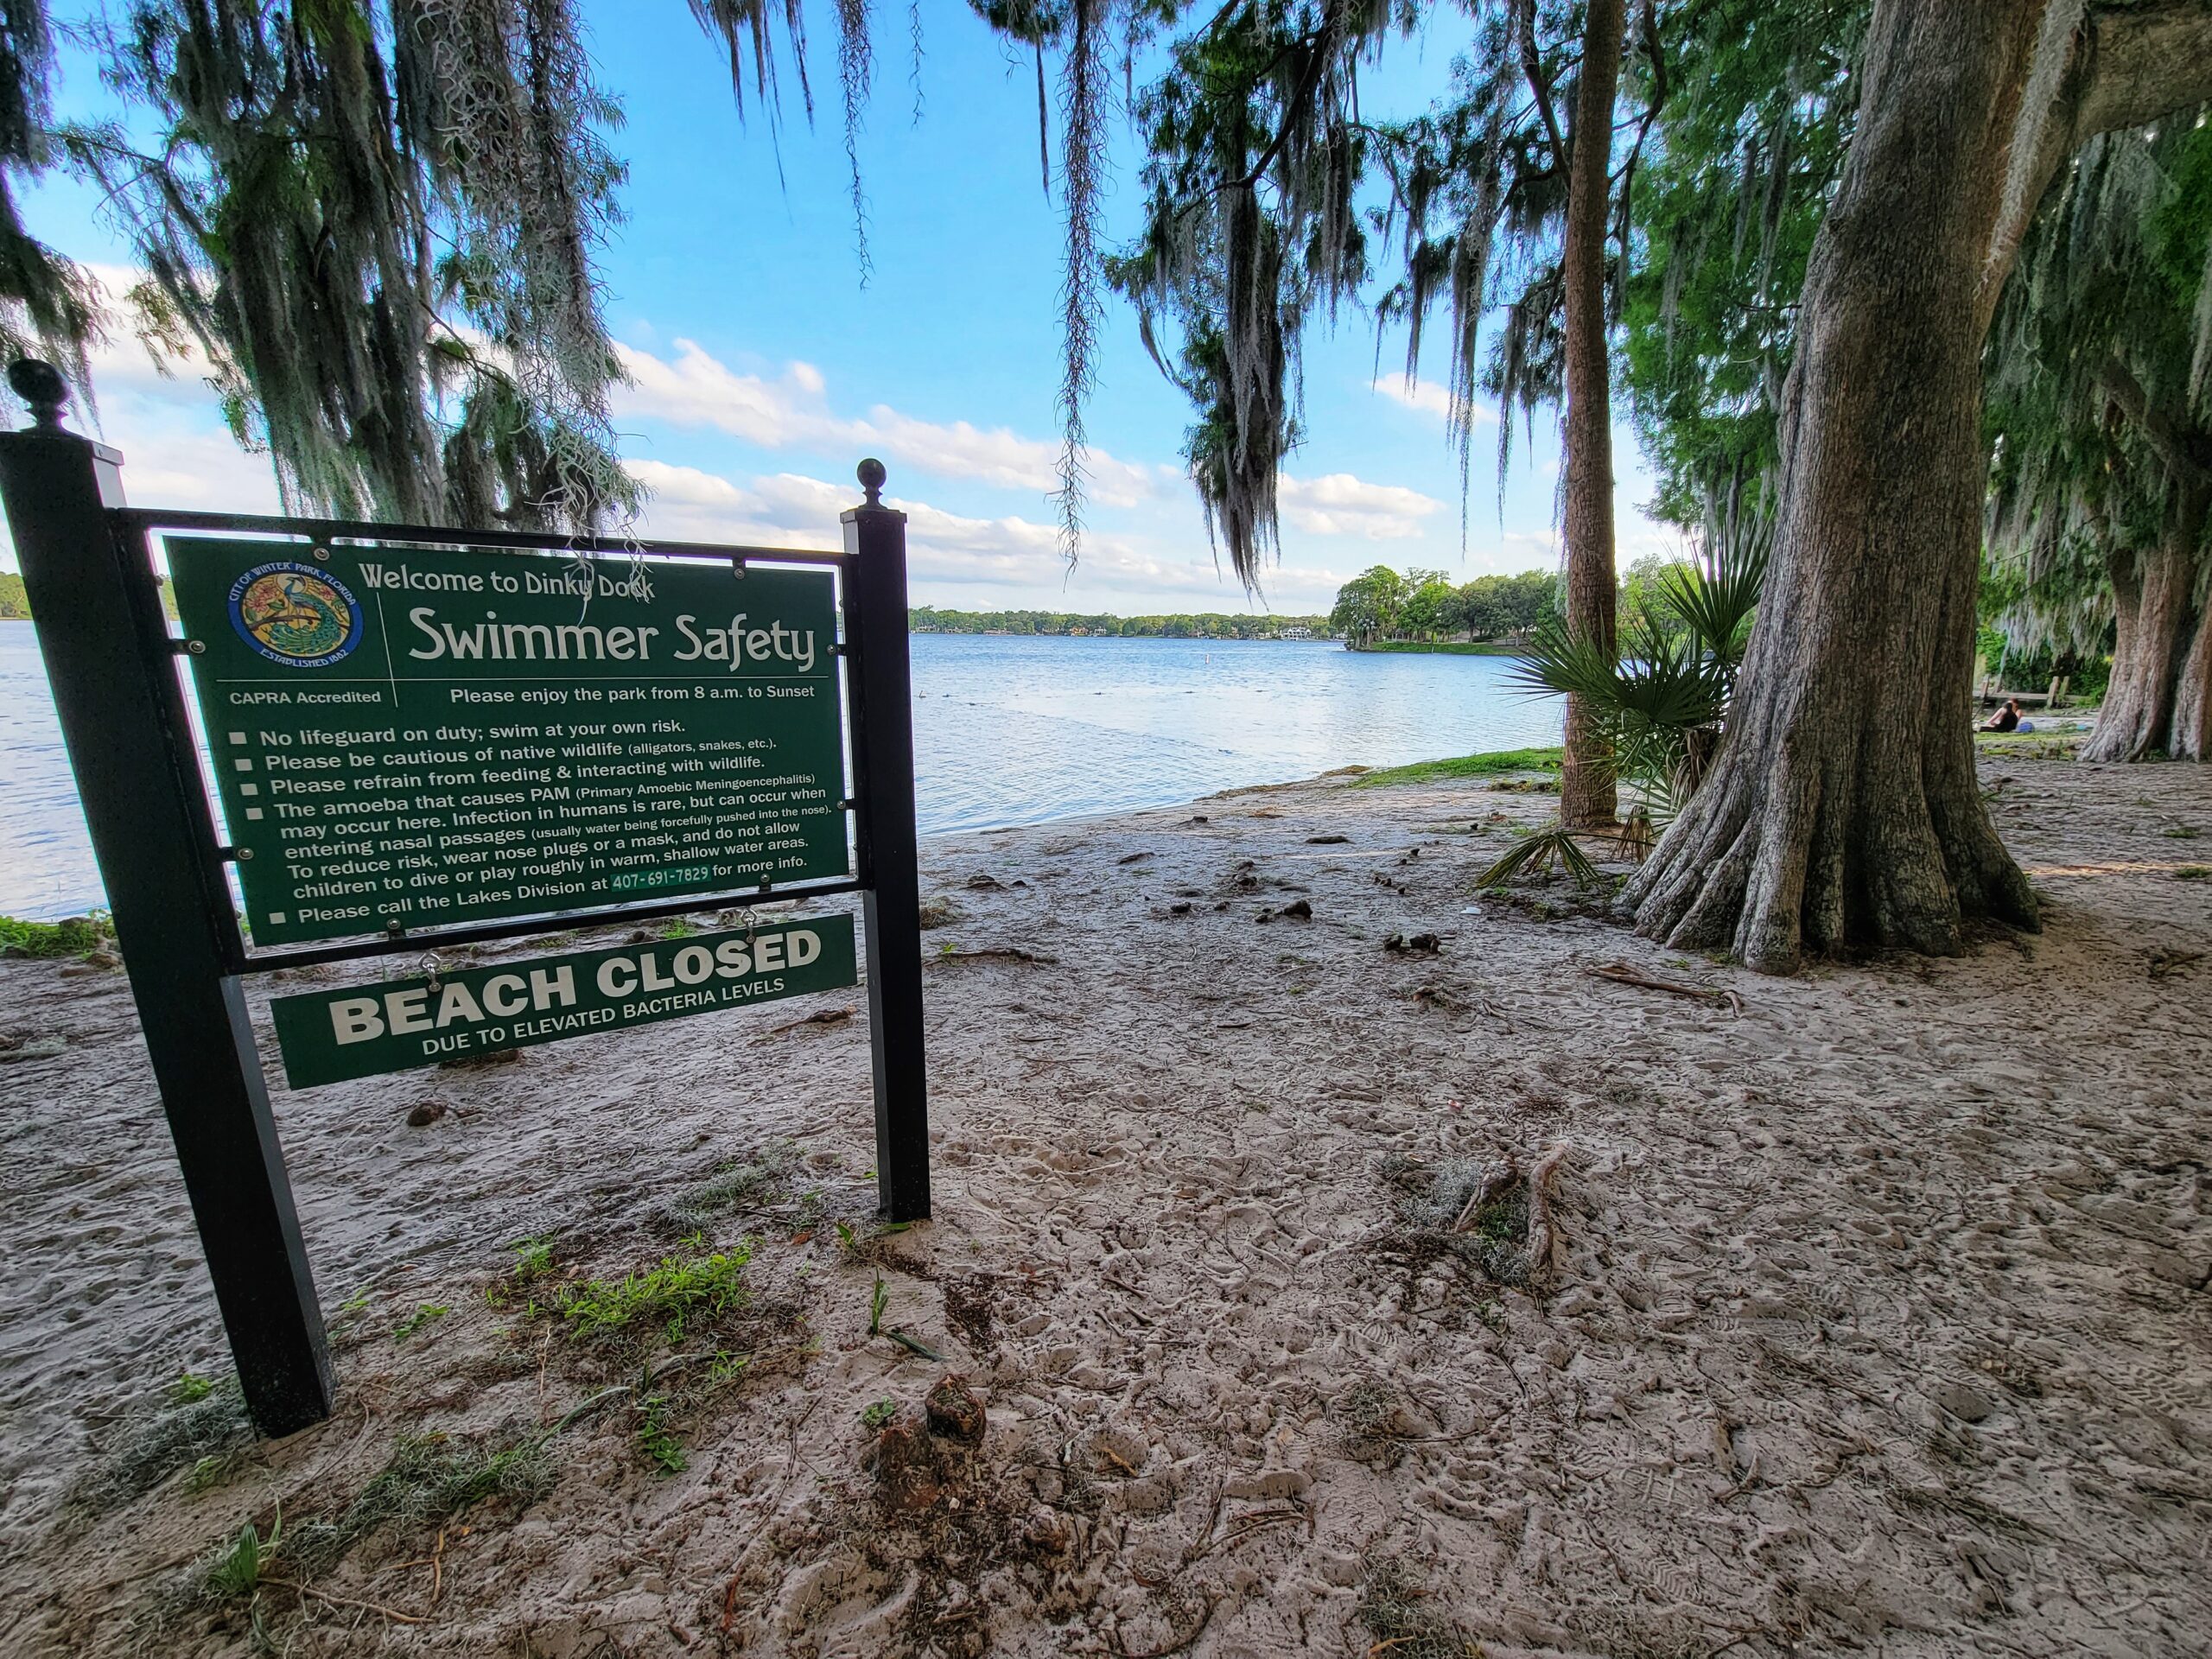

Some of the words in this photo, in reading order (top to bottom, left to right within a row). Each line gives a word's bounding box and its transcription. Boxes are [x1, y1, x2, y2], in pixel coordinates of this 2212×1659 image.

[229, 582, 242, 601] CITY
[240, 573, 251, 584] OF
[251, 563, 290, 576] WINTER
[323, 574, 356, 605] FLORIDA
[359, 563, 483, 591] Welcome
[490, 571, 518, 593] to
[524, 570, 593, 601] Dinky
[260, 648, 329, 667] ESTABLISHED
[409, 607, 659, 659] Swimmer
[674, 613, 814, 672] Safety
[230, 692, 291, 704] CAPRA
[297, 691, 381, 702] Accredited
[451, 690, 514, 702] Please
[522, 689, 568, 704] enjoy
[574, 688, 601, 701] the
[609, 688, 646, 702] park
[651, 687, 689, 699] from
[695, 686, 704, 698] 8
[710, 689, 742, 698] a.m.
[747, 687, 761, 697] to
[767, 686, 814, 697] Sunset
[260, 731, 292, 746] No
[300, 728, 395, 747] lifeguard
[404, 730, 428, 741] on
[435, 727, 482, 742] duty;
[490, 724, 538, 738] swim
[546, 724, 563, 736] at
[569, 725, 606, 738] your
[613, 723, 645, 734] own
[652, 720, 684, 732] risk.
[265, 755, 341, 770] Please
[349, 753, 375, 766] be
[384, 750, 468, 765] cautious
[475, 747, 493, 760] of
[500, 746, 555, 760] native
[562, 742, 622, 757] wildlife
[629, 743, 695, 756] (alligators,
[699, 741, 744, 750] snakes,
[748, 739, 776, 749] etc.).
[270, 779, 346, 794] Please
[354, 774, 422, 790] refrain
[429, 772, 475, 785] from
[481, 768, 551, 783] feeding
[557, 766, 571, 779] &
[577, 762, 666, 777] interacting
[671, 760, 703, 772] with
[709, 756, 764, 769] wildlife.
[274, 804, 315, 817] The
[324, 798, 409, 815] amoeba
[415, 795, 455, 809] that
[461, 793, 524, 805] causes
[531, 787, 569, 801] PAM
[576, 787, 632, 800] (Primary
[638, 782, 692, 794] Amoebic
[696, 774, 815, 790] Meningoencephalitis)
[281, 825, 326, 839] may
[334, 821, 390, 834] occur
[397, 817, 446, 830] here.
[453, 810, 531, 825] Infection
[538, 807, 553, 819] in
[560, 804, 627, 817] humans
[632, 801, 645, 812] is
[652, 800, 685, 810] rare,
[690, 796, 714, 807] but
[719, 796, 744, 805] can
[750, 792, 786, 803] occur
[791, 788, 825, 799] when
[285, 841, 374, 858] entering
[380, 835, 432, 850] nasal
[440, 830, 525, 849] passages
[531, 826, 581, 840] (usually
[586, 823, 620, 834] water
[625, 820, 658, 830] being
[661, 815, 712, 827] forcefully
[716, 811, 755, 824] pushed
[782, 808, 798, 817] the
[802, 805, 831, 815] nose).
[287, 865, 313, 879] To
[321, 861, 391, 876] reduce
[397, 855, 437, 868] risk,
[443, 852, 488, 864] wear
[495, 848, 537, 860] nose
[543, 842, 588, 858] plugs
[594, 841, 609, 850] or
[616, 840, 625, 849] a
[632, 833, 677, 847] mask,
[683, 829, 709, 842] and
[715, 828, 733, 839] do
[738, 825, 760, 836] not
[766, 823, 799, 834] allow
[294, 881, 377, 899] children
[383, 878, 403, 889] to
[410, 874, 448, 887] dive
[455, 872, 474, 882] or
[480, 867, 516, 882] play
[523, 859, 584, 875] roughly
[590, 857, 604, 868] in
[610, 854, 659, 866] warm,
[664, 847, 720, 861] shallow
[725, 842, 763, 854] water
[768, 839, 808, 849] areas.
[299, 906, 370, 923] Please
[378, 899, 411, 913] call
[419, 896, 449, 909] the
[457, 891, 512, 905] Lakes
[518, 882, 585, 898] Division
[592, 878, 608, 890] at
[613, 867, 709, 889] 407-691-7829
[713, 865, 732, 875] for
[738, 861, 773, 873] more
[779, 856, 806, 868] info.
[329, 966, 576, 1046] BEACH
[596, 929, 823, 998] CLOSED
[423, 1033, 470, 1054] DUE
[476, 1027, 505, 1044] TO
[514, 1008, 615, 1038] ELEVATED
[624, 990, 715, 1018] BACTERIA
[722, 978, 784, 1000] LEVELS
